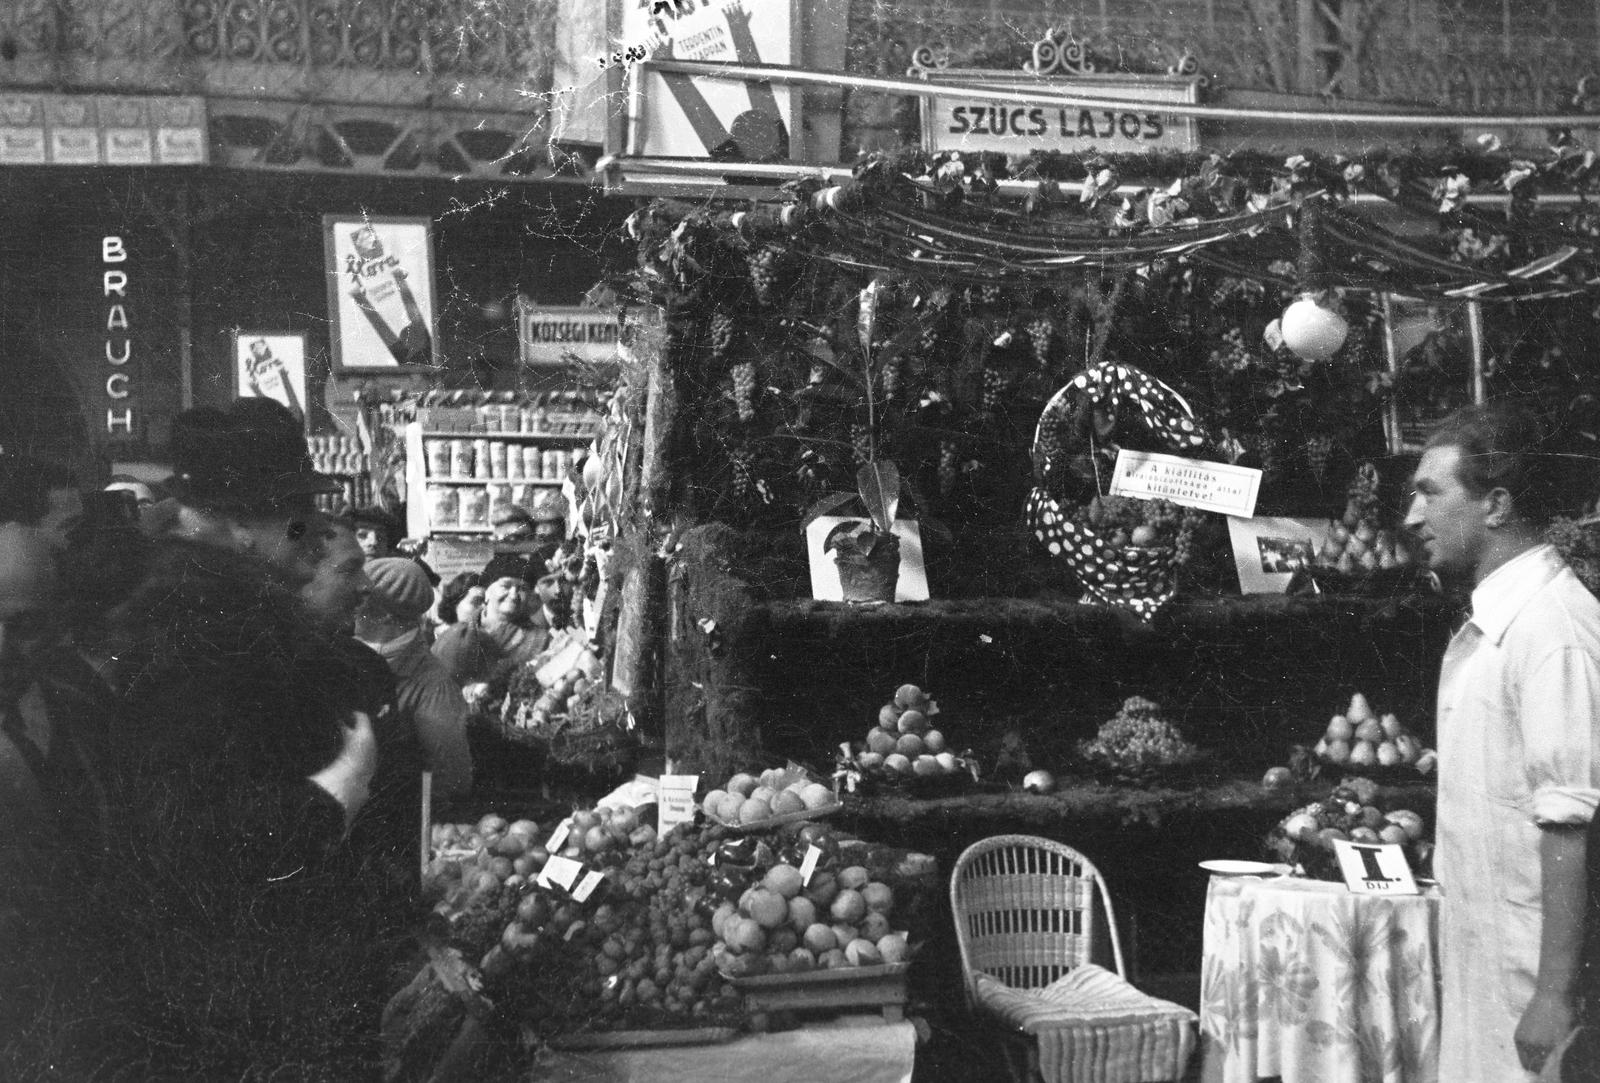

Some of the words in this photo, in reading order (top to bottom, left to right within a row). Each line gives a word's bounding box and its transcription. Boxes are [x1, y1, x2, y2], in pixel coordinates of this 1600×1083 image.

[1059, 109, 1164, 140] LAJOS
[102, 236, 131, 433] BRAUCH
[1151, 464, 1157, 474] A
[1351, 845, 1402, 881] I.
